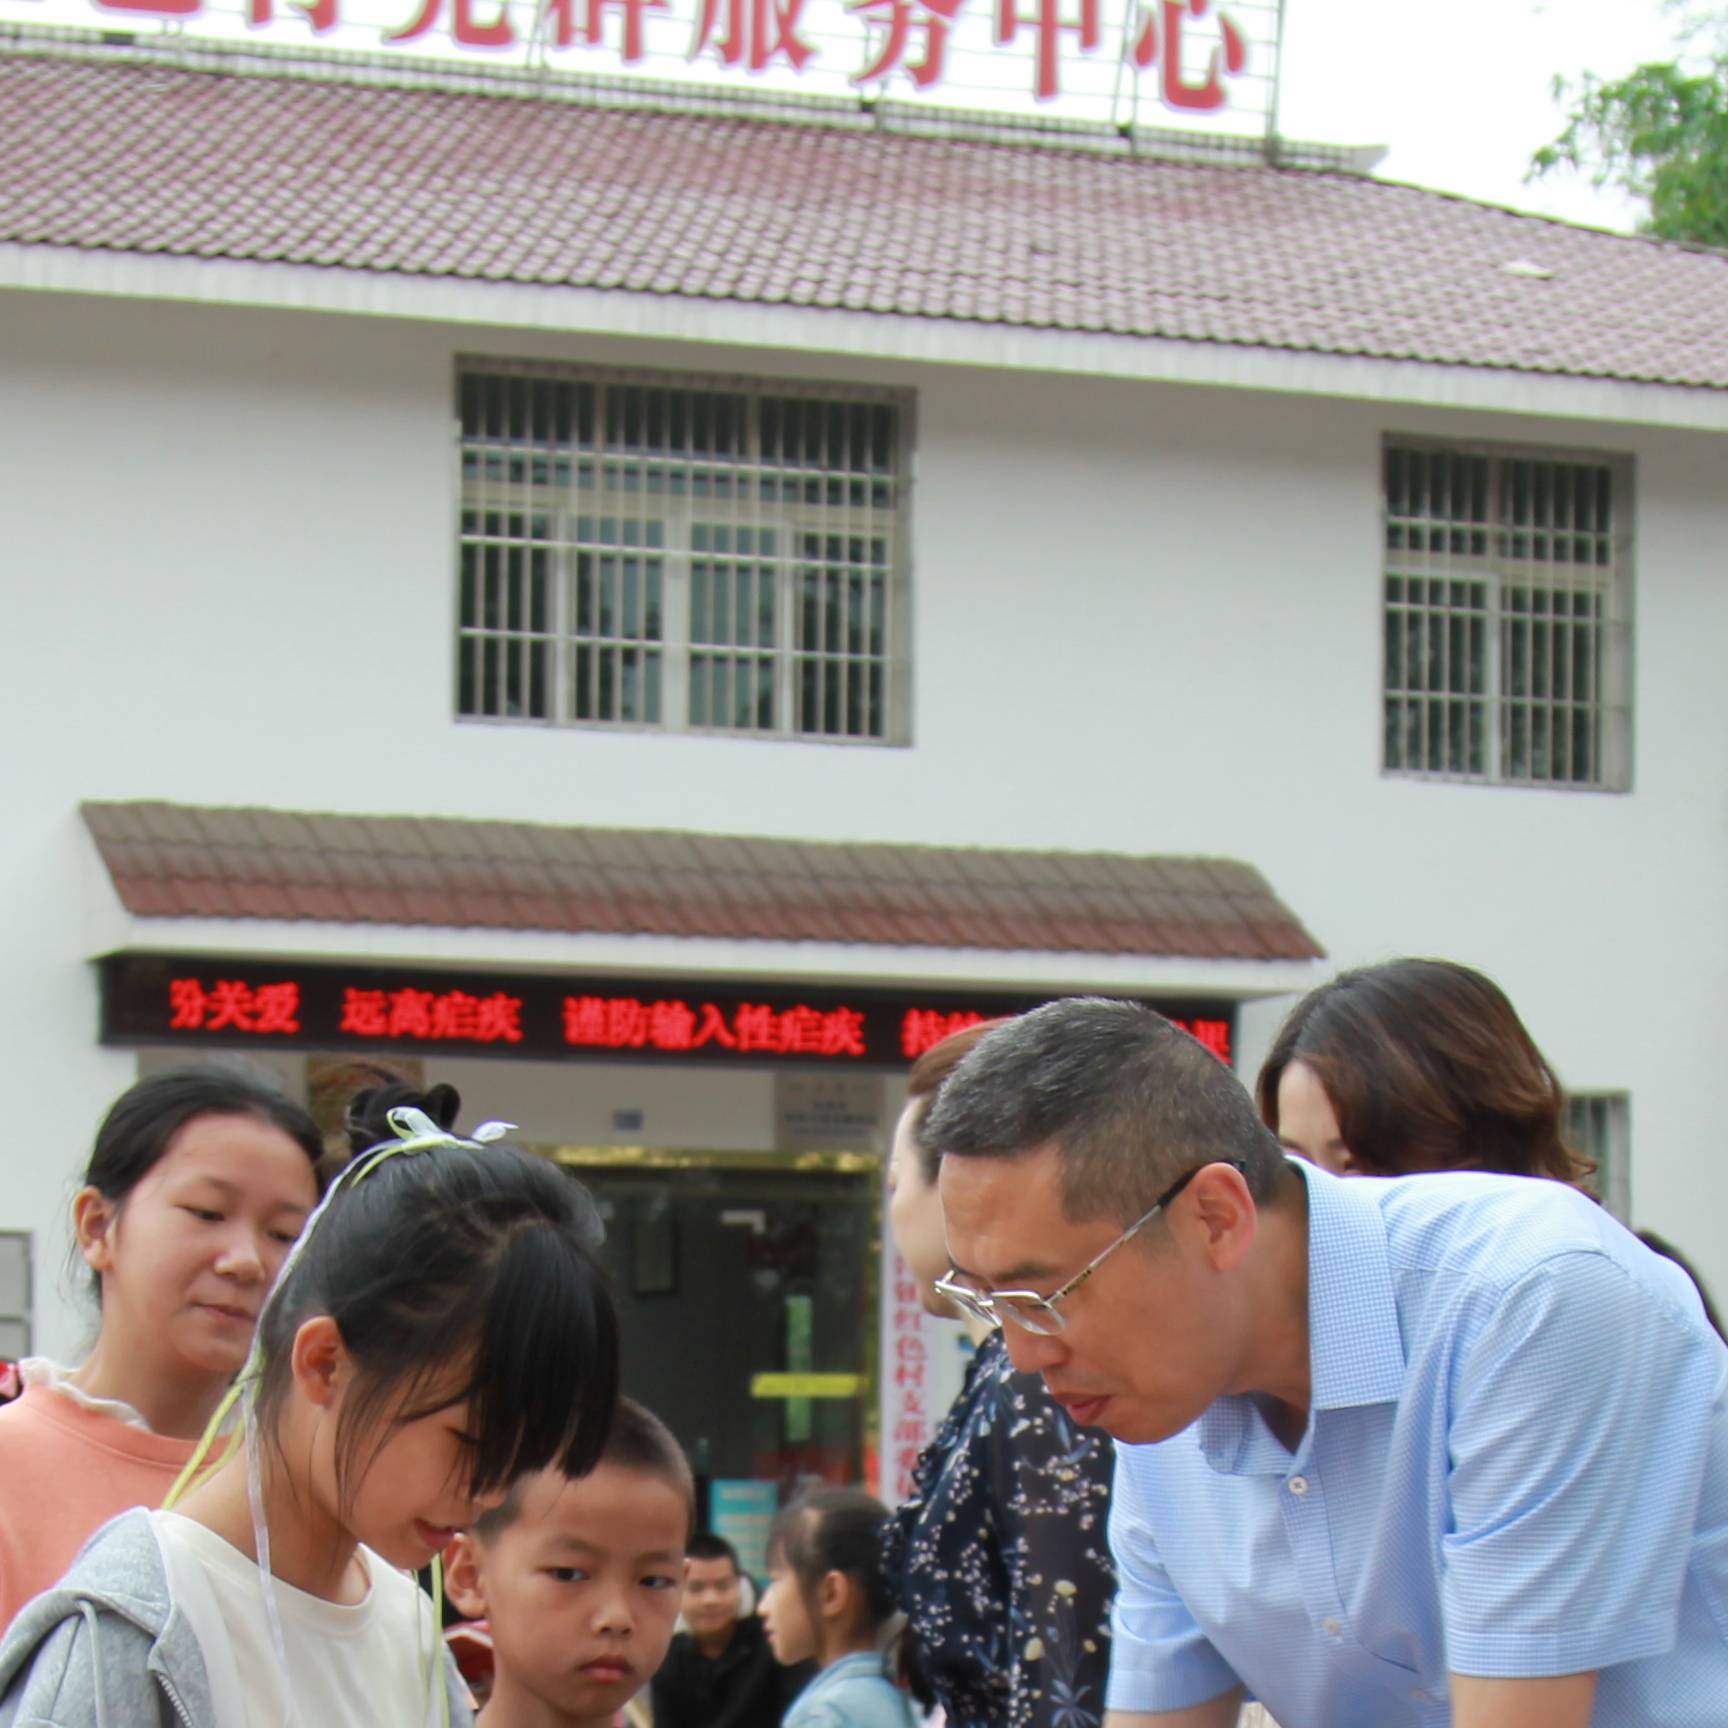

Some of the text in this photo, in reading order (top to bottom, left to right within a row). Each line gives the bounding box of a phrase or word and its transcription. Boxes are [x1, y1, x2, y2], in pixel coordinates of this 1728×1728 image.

[562, 995, 867, 1056] 谨防输入性疟疾
